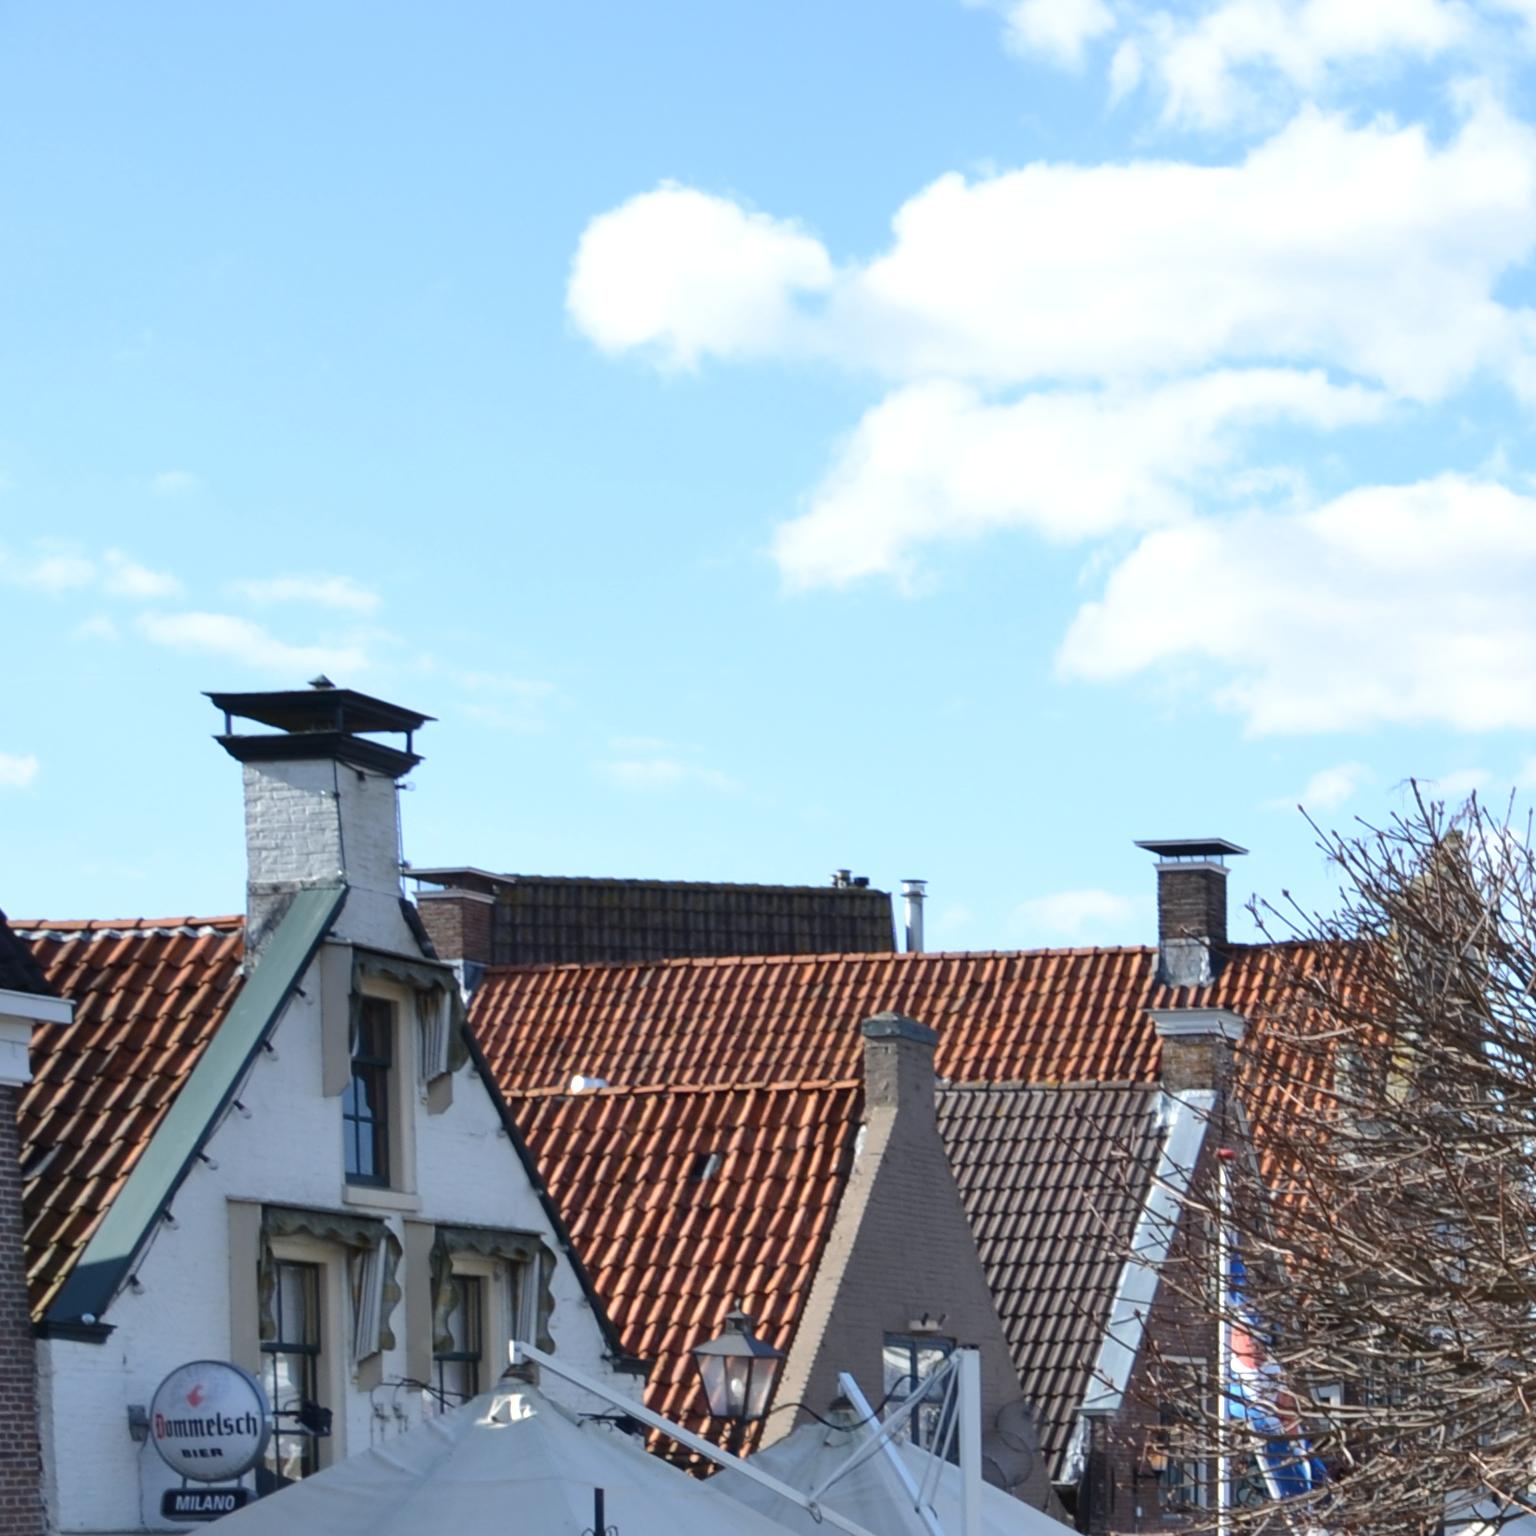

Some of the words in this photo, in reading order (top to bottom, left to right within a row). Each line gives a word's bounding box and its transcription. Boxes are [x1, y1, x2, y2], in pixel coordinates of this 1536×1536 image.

[155, 1411, 258, 1439] Dommelsch
[181, 1448, 224, 1459] BIER
[175, 1495, 236, 1511] MILANO
